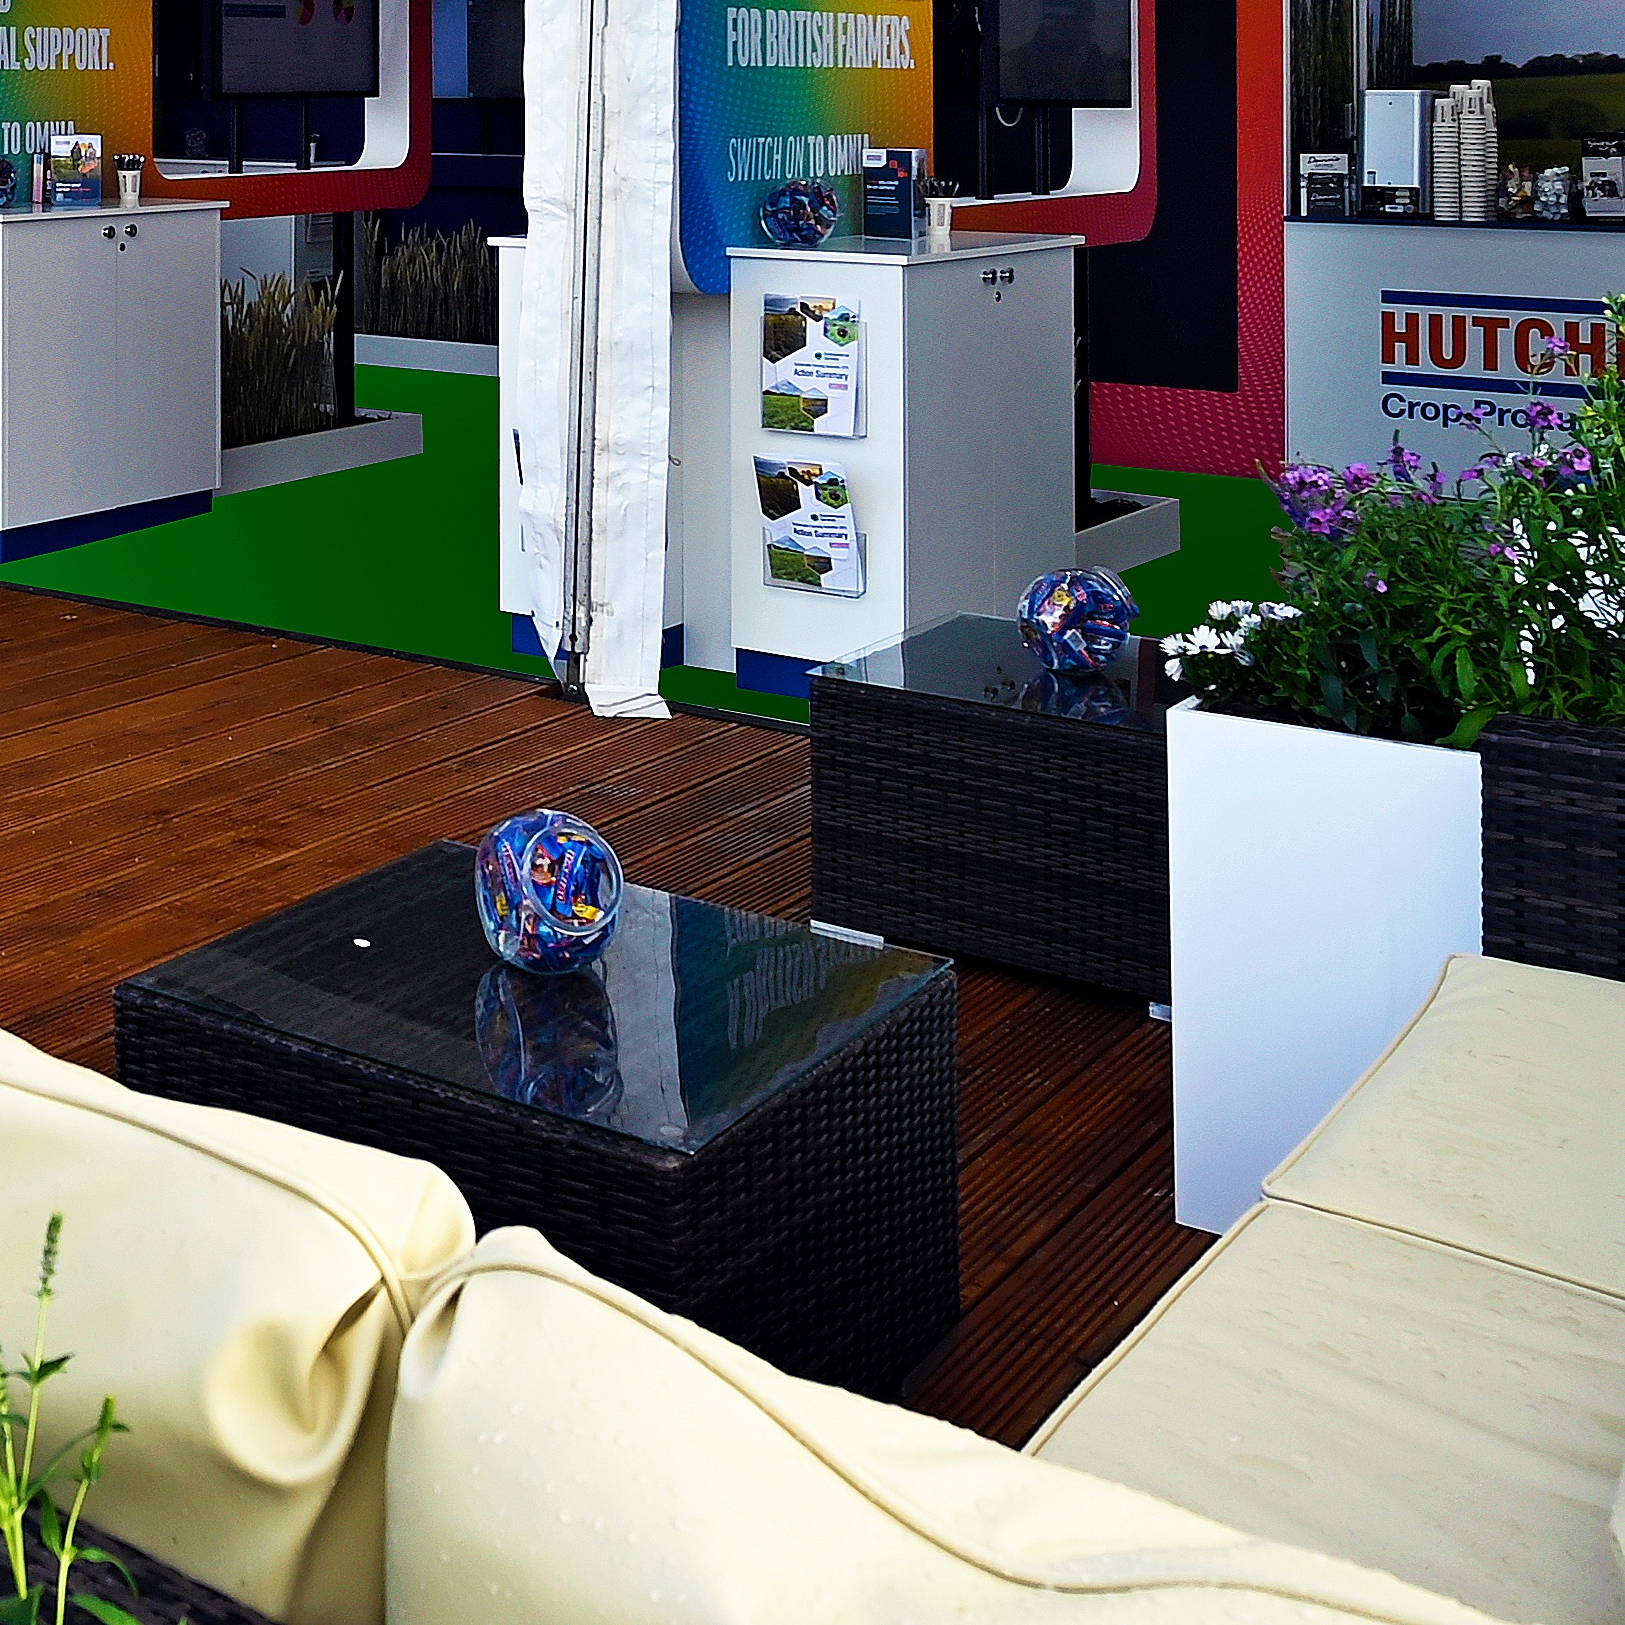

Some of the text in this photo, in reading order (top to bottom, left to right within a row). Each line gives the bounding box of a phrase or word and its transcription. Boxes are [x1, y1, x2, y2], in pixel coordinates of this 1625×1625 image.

[25, 27, 114, 70] SUPPORT.
[727, 7, 915, 69] FOR BRITISH FARMERS.
[2, 121, 20, 154] TO
[728, 137, 780, 182] SWITCH
[785, 136, 804, 179] ON
[808, 135, 824, 177] TO
[1382, 392, 1462, 427] Crop
